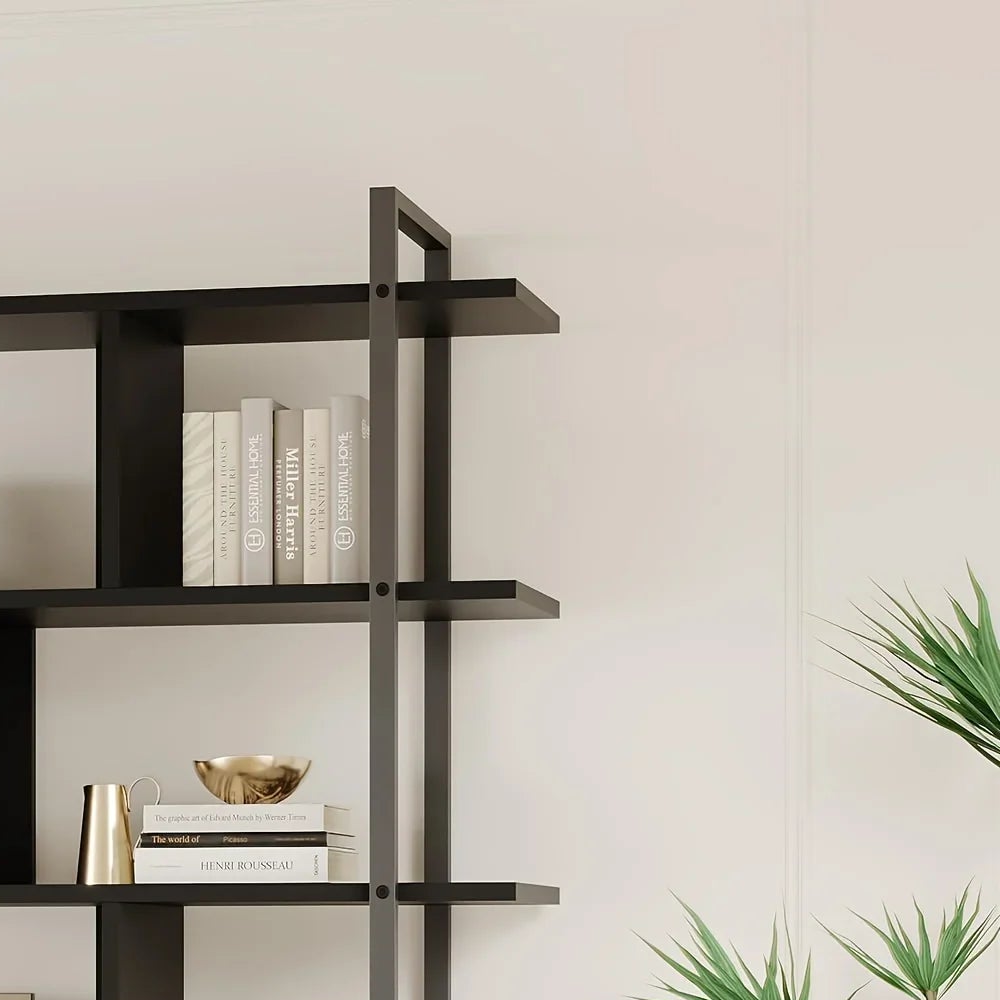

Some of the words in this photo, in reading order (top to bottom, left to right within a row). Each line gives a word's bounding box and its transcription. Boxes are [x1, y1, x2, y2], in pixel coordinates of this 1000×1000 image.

[248, 433, 260, 469] HOME
[338, 431, 349, 466] HOME
[285, 447, 299, 500] Miller
[248, 470, 260, 523] ESSENTIAL
[338, 468, 349, 521] ESSENTIAL
[285, 504, 299, 560] Harris
[154, 814, 167, 822] The
[168, 813, 190, 824] graphic
[255, 813, 263, 823] by
[264, 813, 286, 821] Werner
[152, 835, 167, 843] The
[167, 835, 190, 843] world
[191, 835, 201, 843] of
[222, 835, 249, 843] Picasso
[201, 861, 234, 871] HENRI
[237, 860, 294, 871] ROUSSEAU
